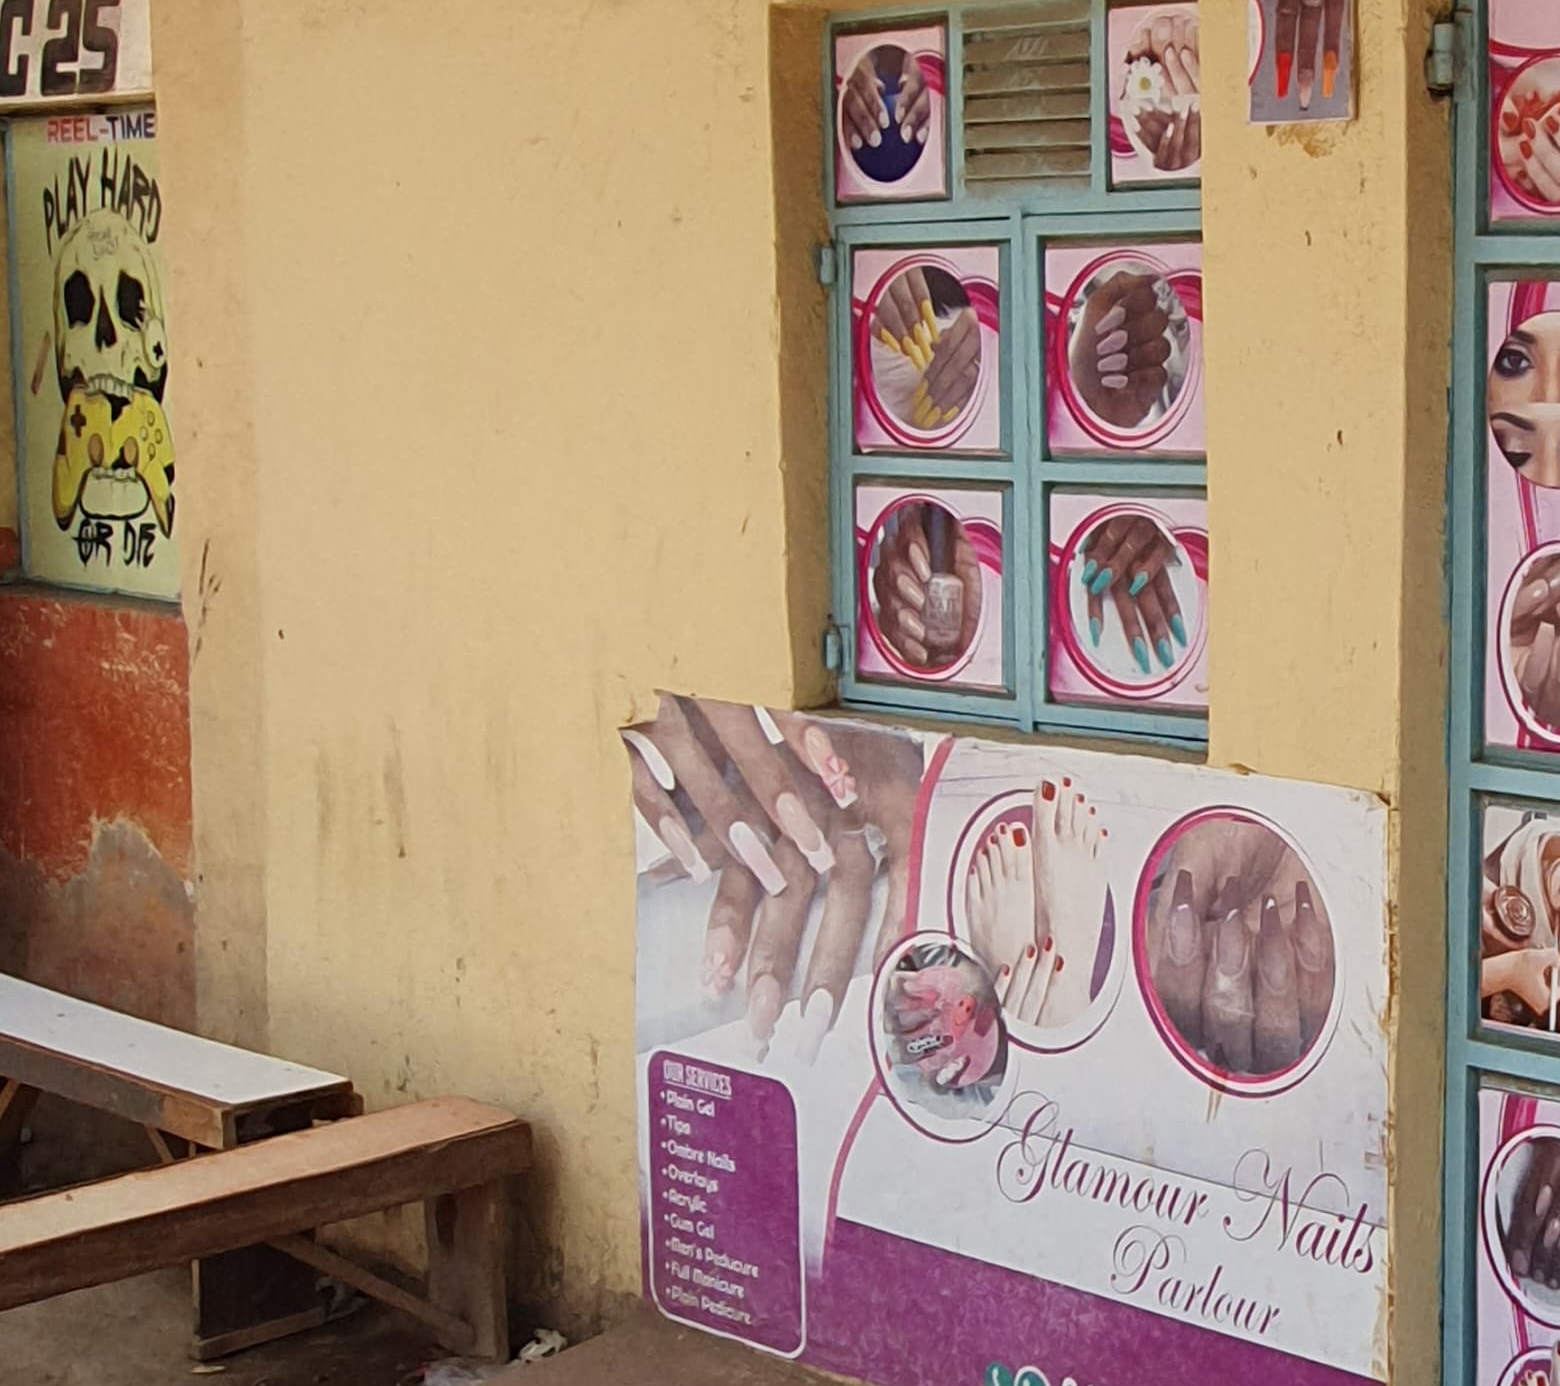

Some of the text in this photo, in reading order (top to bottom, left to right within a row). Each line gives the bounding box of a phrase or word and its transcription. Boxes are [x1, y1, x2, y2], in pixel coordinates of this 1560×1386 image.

[47, 114, 156, 143] REEL-TIME
[43, 144, 162, 259] PLAY HARD
[995, 1089, 1376, 1274] Glamour Nails
[1109, 1224, 1281, 1336] Parlour
